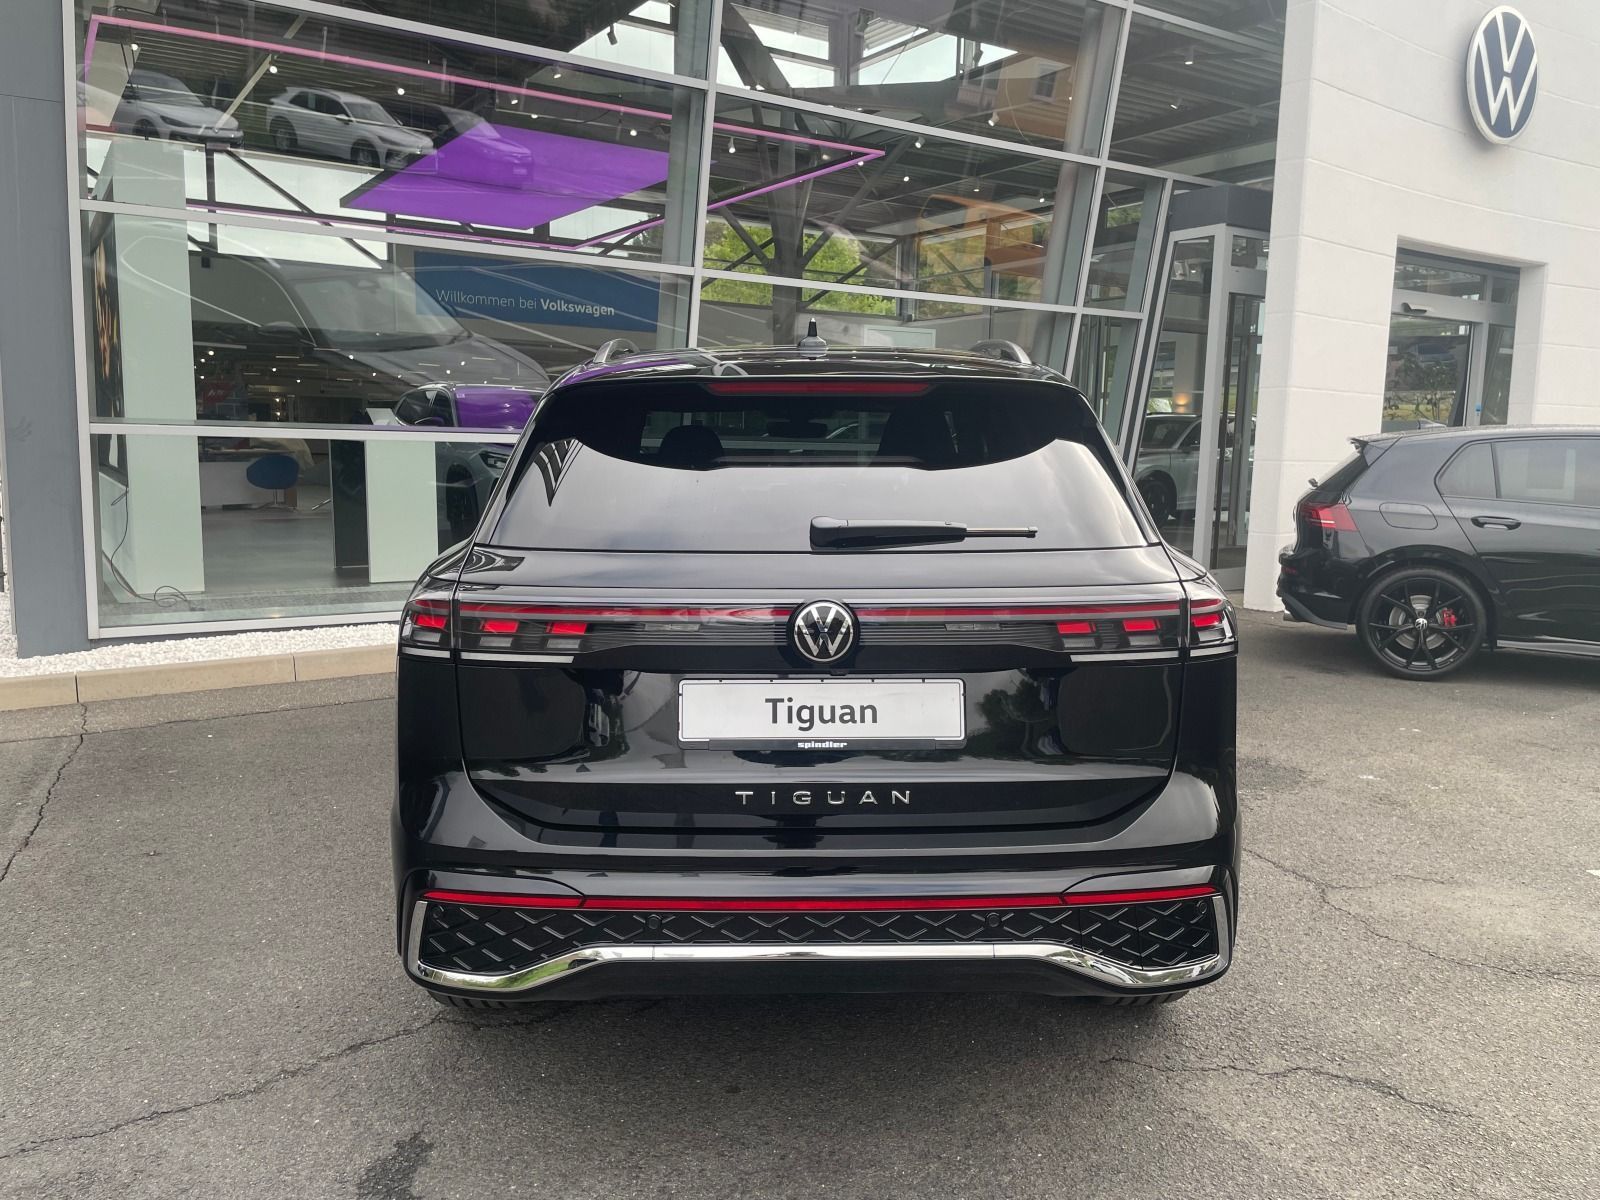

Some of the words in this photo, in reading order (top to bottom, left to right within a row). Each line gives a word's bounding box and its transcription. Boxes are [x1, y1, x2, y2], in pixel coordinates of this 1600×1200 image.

[1470, 6, 1538, 140] VW
[435, 288, 515, 308] Willkommen
[519, 296, 537, 309] bei
[540, 298, 615, 317] Volkswagen
[796, 603, 852, 659] VW
[765, 697, 878, 732] Tiguan
[797, 740, 848, 749] spindler
[734, 790, 911, 805] TIGUAN
